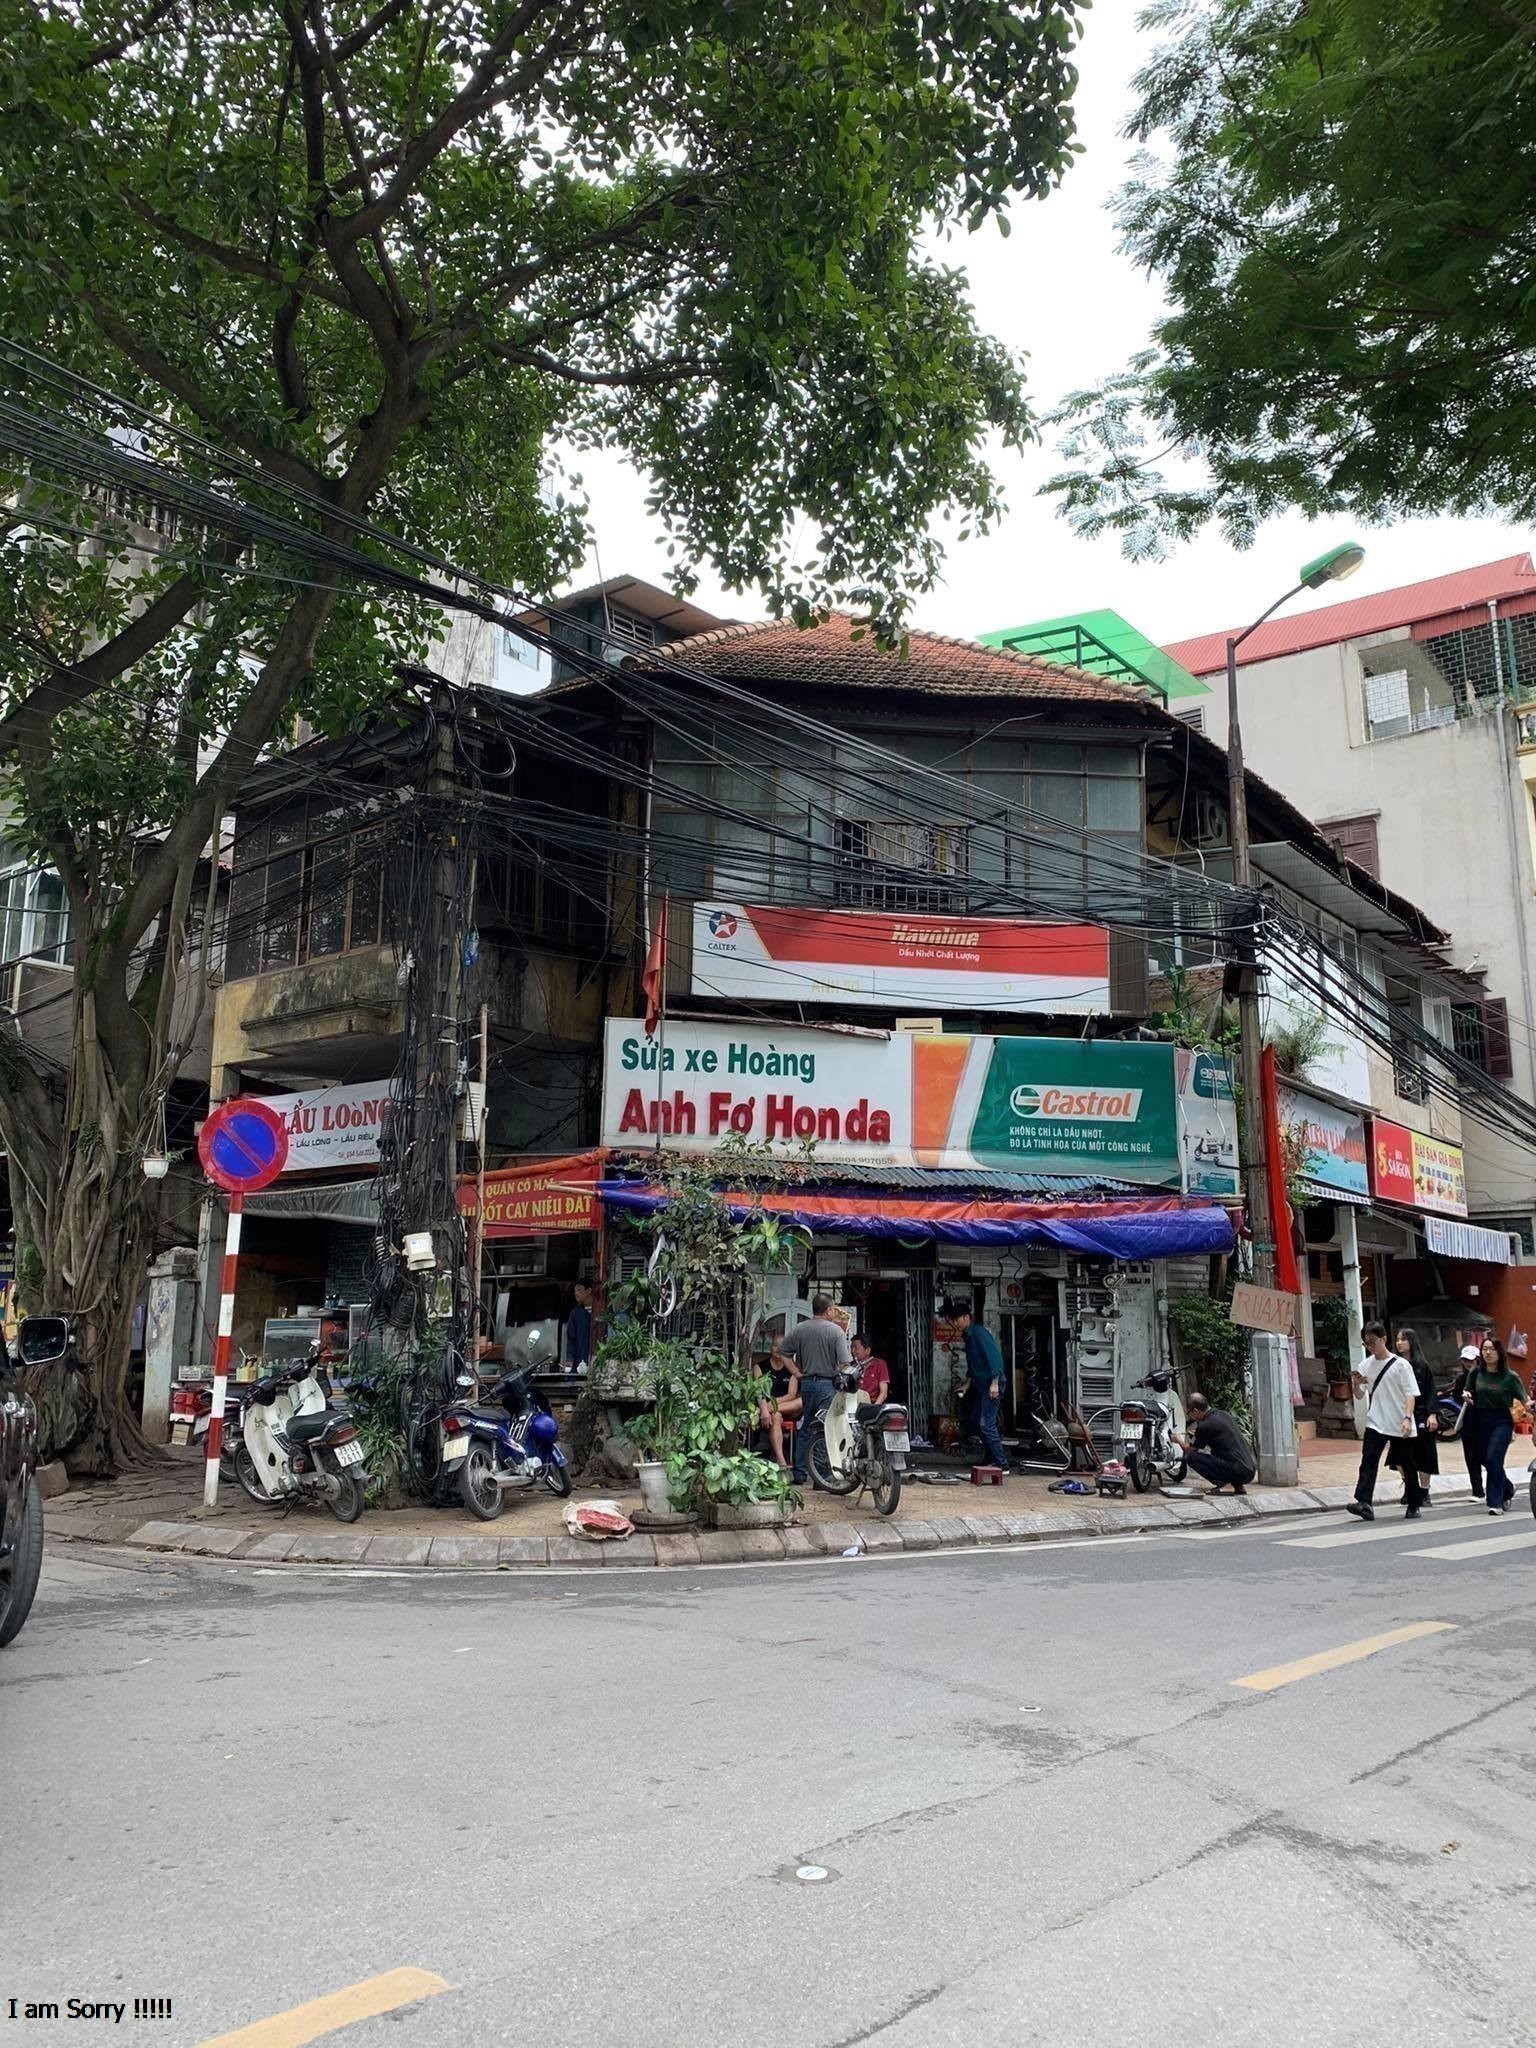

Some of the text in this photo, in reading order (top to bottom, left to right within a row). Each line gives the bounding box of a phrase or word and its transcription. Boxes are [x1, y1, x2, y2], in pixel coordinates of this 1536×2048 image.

[707, 943, 737, 951] CALTEX
[621, 1035, 815, 1084] Sửa xe Hoàng
[1042, 1089, 1132, 1117] Castrol
[618, 1088, 891, 1143] Anh Fơ Honda
[1009, 1125, 1036, 1137] KHÔNG
[1033, 1139, 1052, 1149] TINH
[1053, 1140, 1069, 1150] HOA
[1107, 1141, 1129, 1152] CÔNG
[486, 1182, 515, 1198] QUÁN
[517, 1178, 531, 1192] CÔ
[505, 1201, 530, 1220] CAY
[532, 1195, 562, 1217] NIÊU
